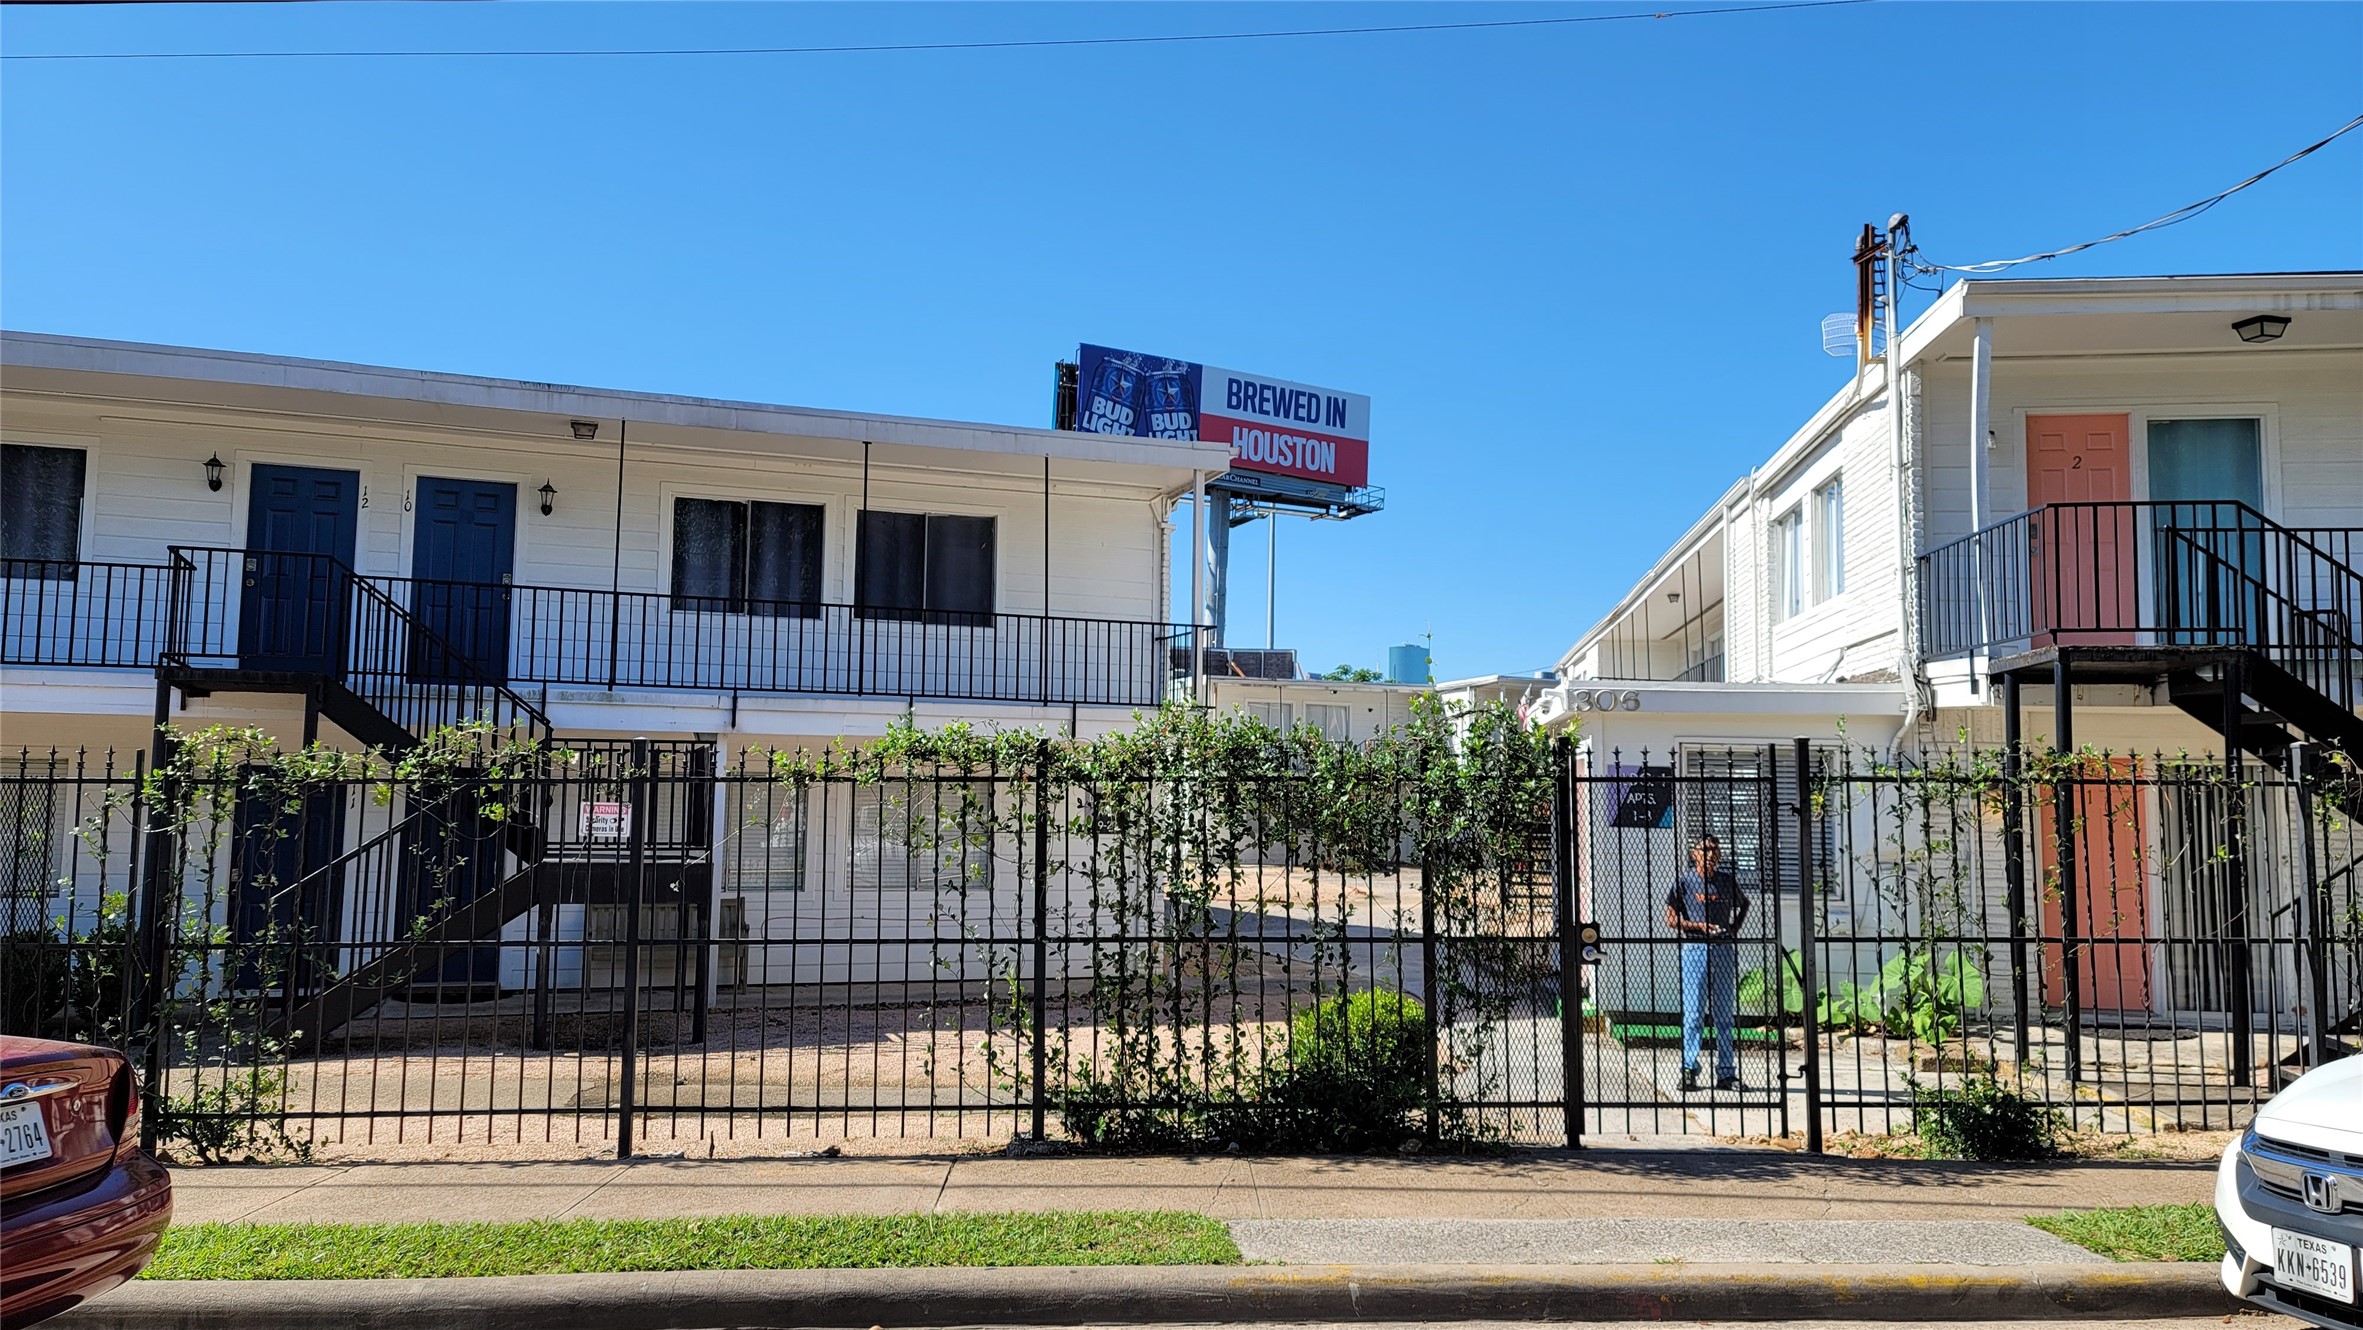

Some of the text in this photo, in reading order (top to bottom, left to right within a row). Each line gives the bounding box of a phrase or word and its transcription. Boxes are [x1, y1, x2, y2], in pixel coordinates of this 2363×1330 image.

[1091, 395, 1134, 426] BUD
[1226, 377, 1347, 429] BREWED IN
[1150, 412, 1192, 431] BUD
[1232, 426, 1336, 474] HOUSTON
[2071, 455, 2082, 470] 2
[1573, 689, 1640, 712] 306
[2086, 789, 2093, 805] 1
[585, 824, 608, 832] Cmeras
[4, 1121, 43, 1153] 2764
[2296, 1237, 2327, 1255] TEXAS
